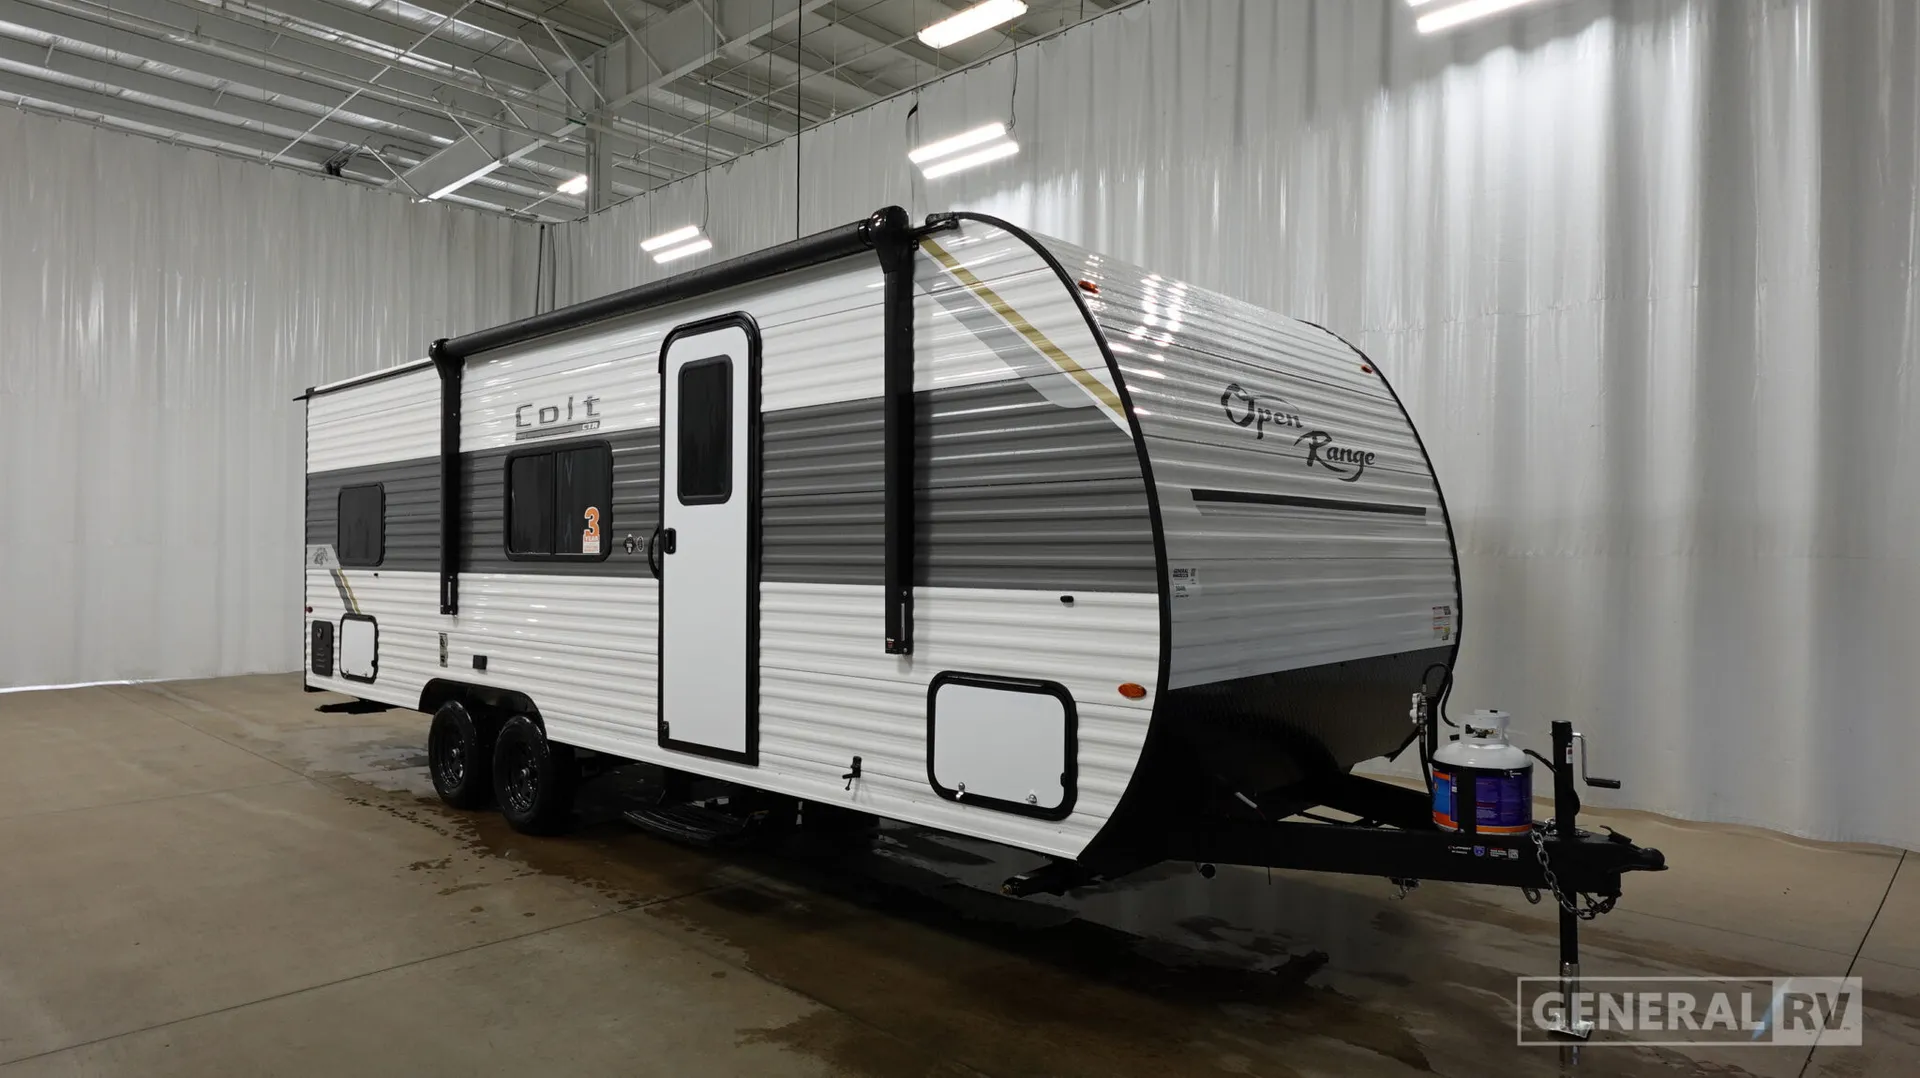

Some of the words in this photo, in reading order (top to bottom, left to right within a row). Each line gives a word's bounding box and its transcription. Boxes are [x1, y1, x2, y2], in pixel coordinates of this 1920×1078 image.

[515, 396, 600, 428] Colt
[1220, 383, 1304, 440] Open
[1293, 430, 1376, 483] Range
[583, 506, 600, 536] 3
